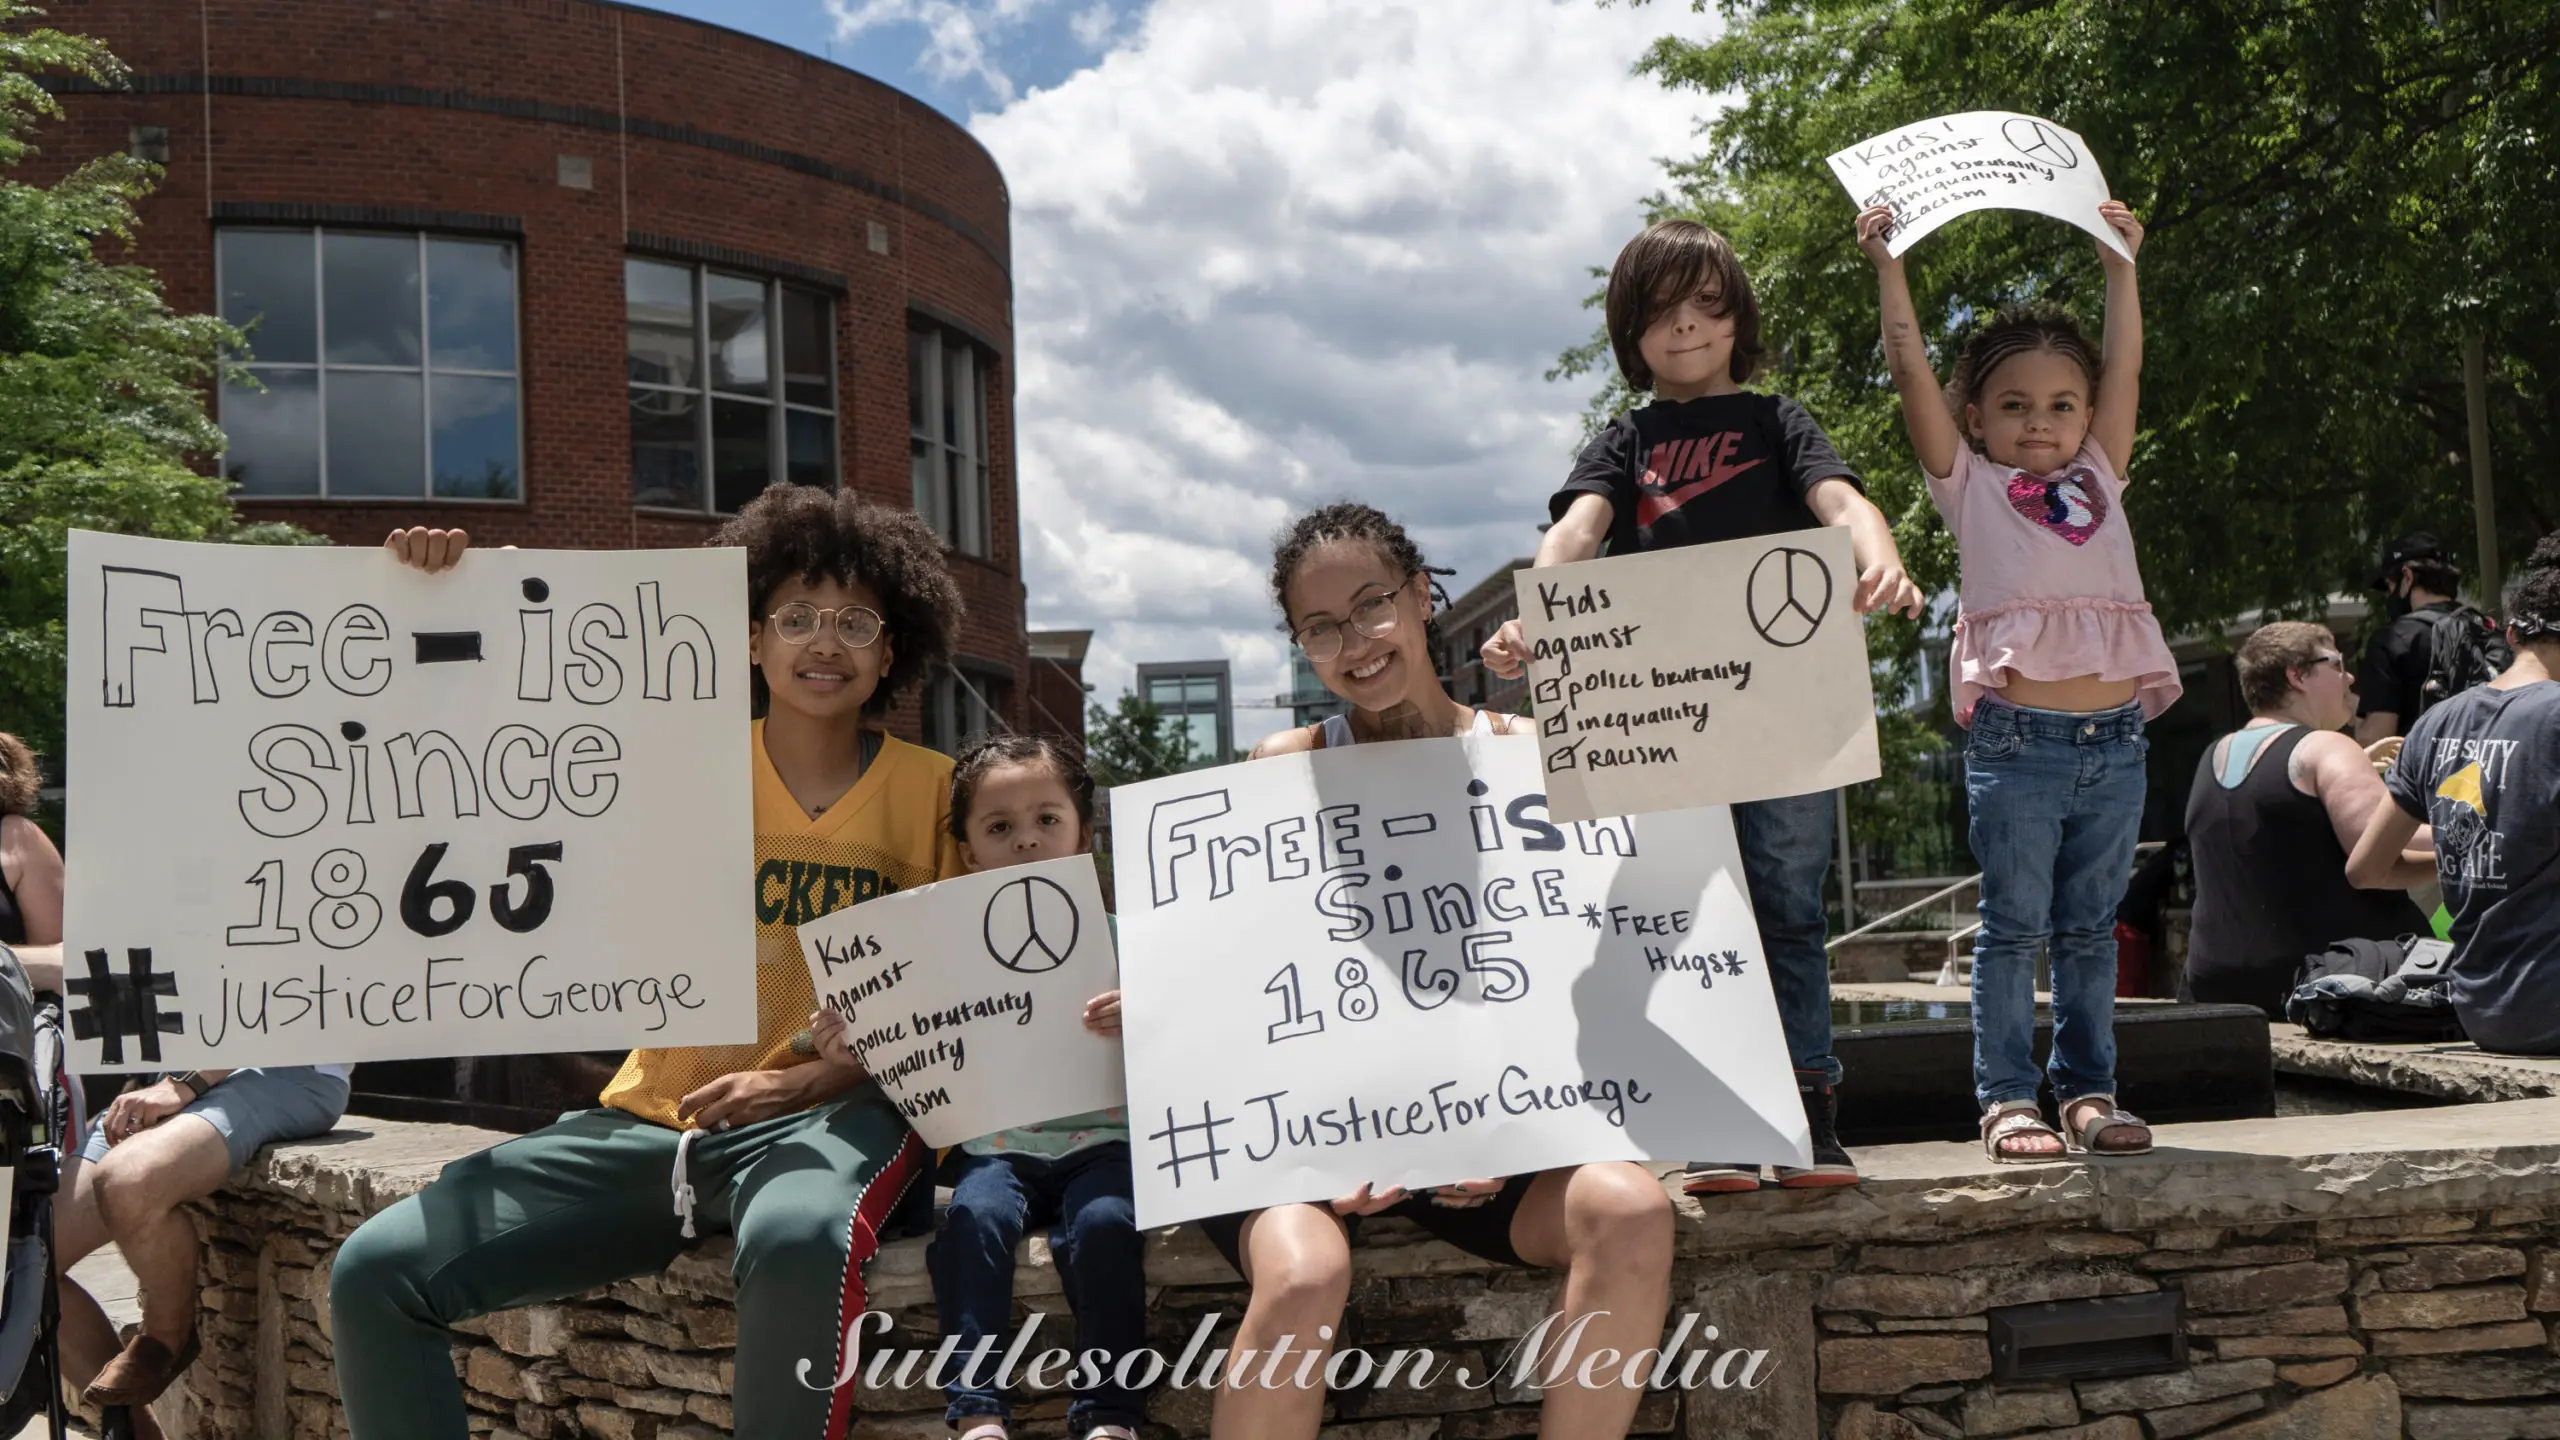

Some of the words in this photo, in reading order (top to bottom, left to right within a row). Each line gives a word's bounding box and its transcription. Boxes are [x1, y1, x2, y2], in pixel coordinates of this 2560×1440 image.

[1878, 138, 1984, 179] against
[1880, 166, 1946, 200] police
[1951, 159, 2055, 181] brutality
[1643, 431, 1744, 486] NIKE
[1537, 582, 1612, 623] Kids
[101, 563, 717, 708] Free-ish
[1534, 623, 1642, 676] against
[1568, 671, 1644, 710] police
[1651, 660, 1752, 691] brutality
[237, 720, 622, 838] Since
[226, 841, 563, 949] 1865
[755, 858, 899, 926] CKER
[814, 933, 882, 977] Kids
[825, 959, 913, 1024] against
[1263, 929, 1530, 1045] 1865
[857, 1022, 907, 1069] police
[911, 990, 1034, 1037] brutality
